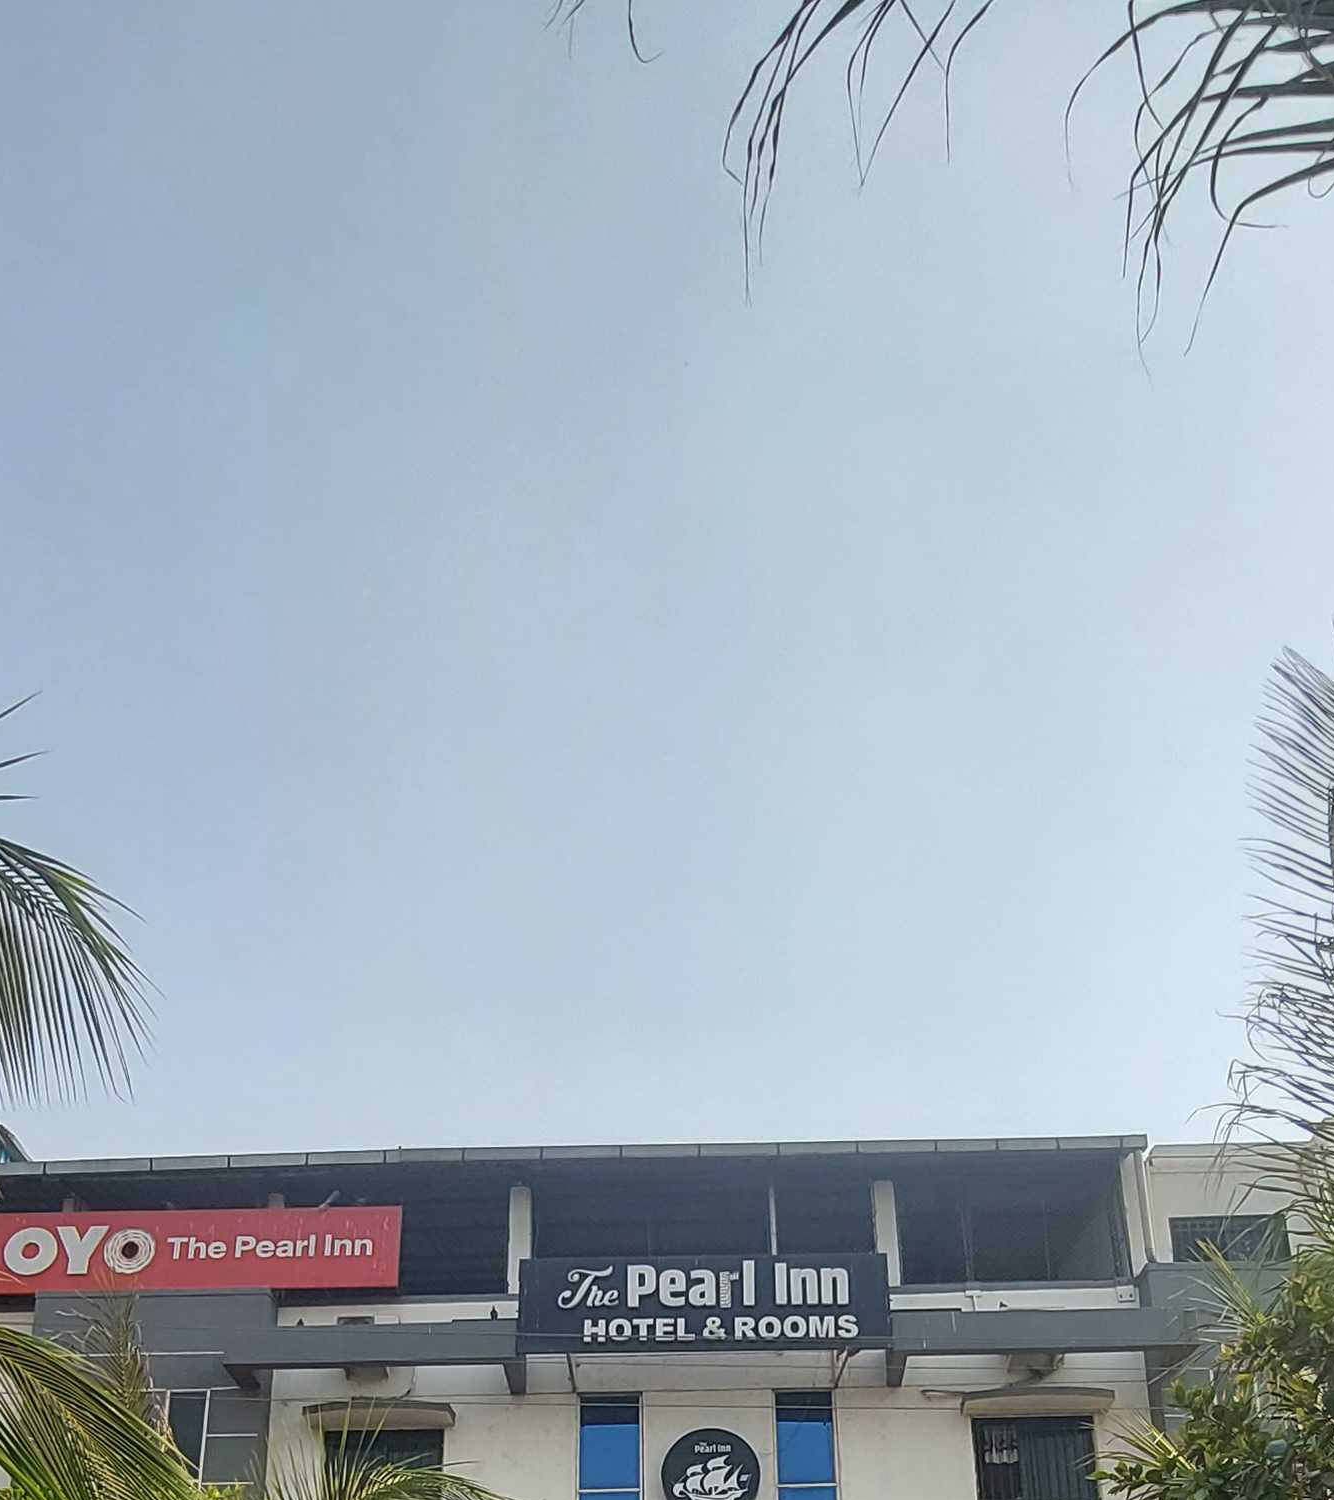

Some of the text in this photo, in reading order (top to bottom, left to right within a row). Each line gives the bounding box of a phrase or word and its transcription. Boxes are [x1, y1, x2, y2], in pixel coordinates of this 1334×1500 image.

[3, 1225, 373, 1276] OYO The Pearl Inn
[557, 1259, 850, 1309] The Pearl Inn
[583, 1314, 860, 1342] HOTEL & ROOMS
[694, 1444, 716, 1453] Pearl
[717, 1444, 732, 1452] Inn
